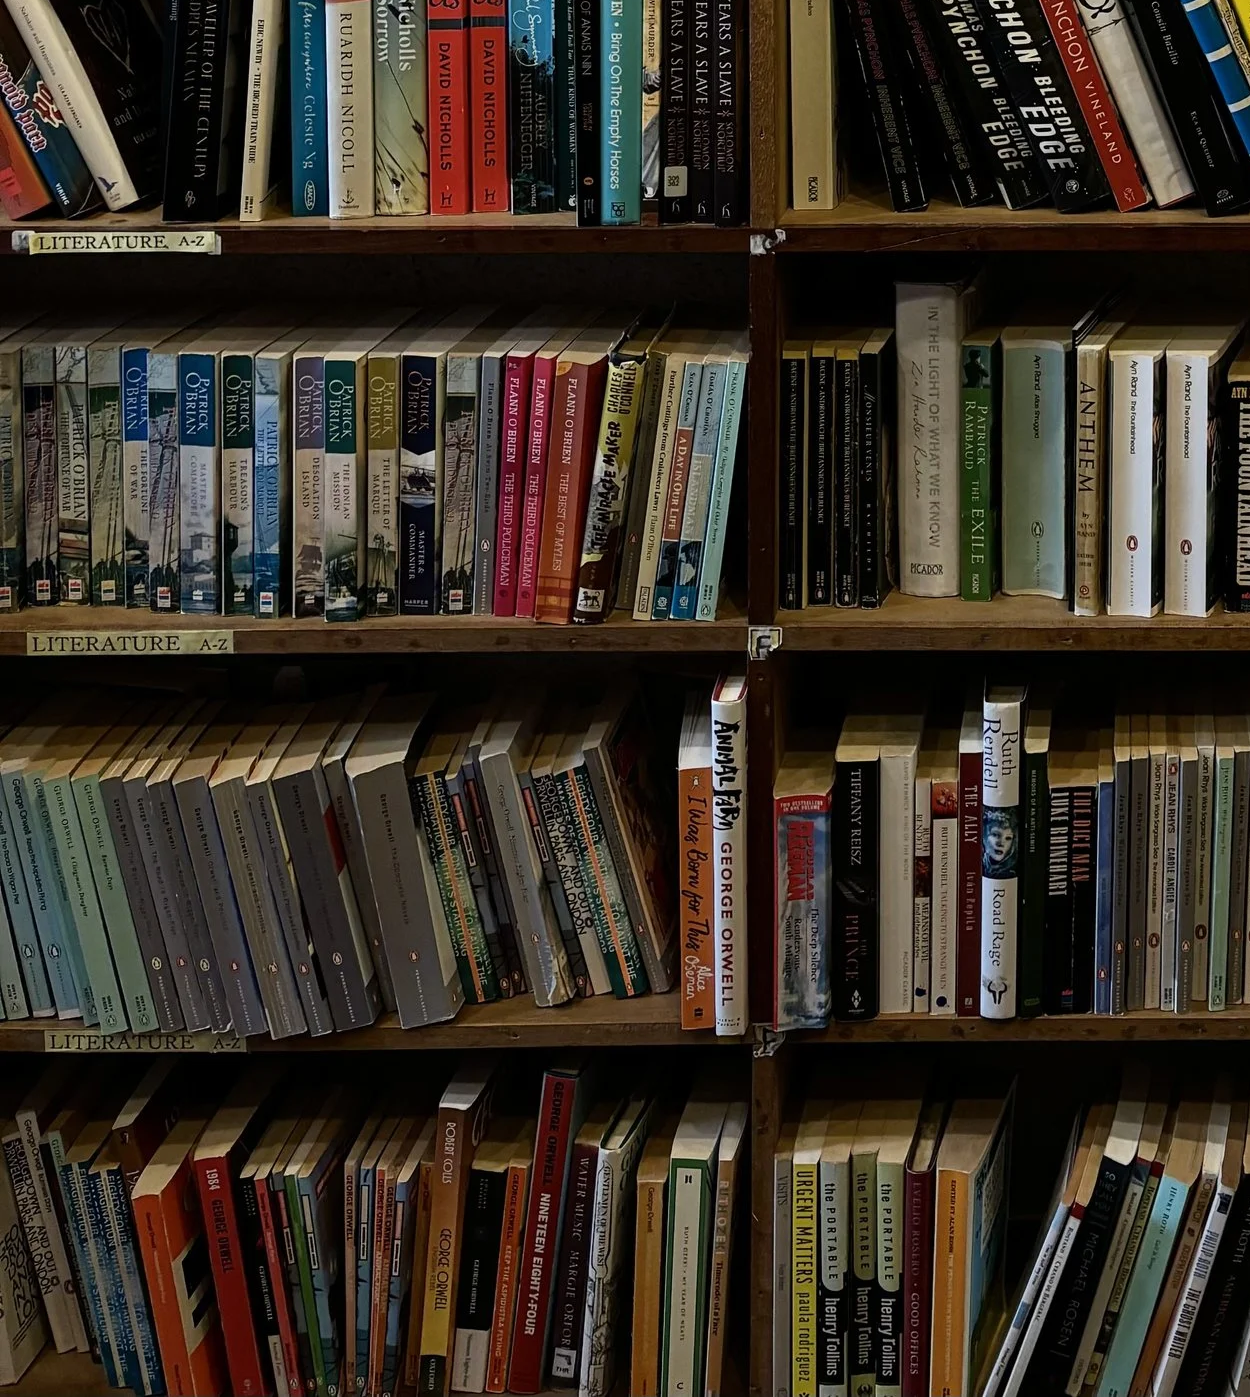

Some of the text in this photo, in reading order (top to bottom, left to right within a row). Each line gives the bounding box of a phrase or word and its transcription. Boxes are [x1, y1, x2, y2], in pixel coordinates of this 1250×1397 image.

[339, 12, 356, 174] RUARIDH NICOLL
[1034, 76, 1086, 155] BLEEDING
[1085, 81, 1123, 165] VINELAND
[1019, 106, 1075, 173] EDGE
[39, 236, 205, 249] LITERATURE A-Z
[506, 378, 520, 463] FLANN O'BRIEN
[1231, 388, 1249, 400] AYN
[1078, 381, 1097, 494] ANTHEM
[909, 562, 944, 576] PICADOR
[32, 636, 228, 651] LITERATURE A-Z
[982, 718, 1001, 790] Rendell
[1000, 731, 1019, 777] Ruth
[712, 719, 740, 1008] ANIMAL FARM GEORGE ORWELL
[49, 1035, 241, 1050] LITERATURE A-Z
[205, 1169, 219, 1192] 1984
[796, 1171, 814, 1285] URGENT MATTERS
[524, 1193, 551, 1336] NINETEEN EIGHTY-FOUR
